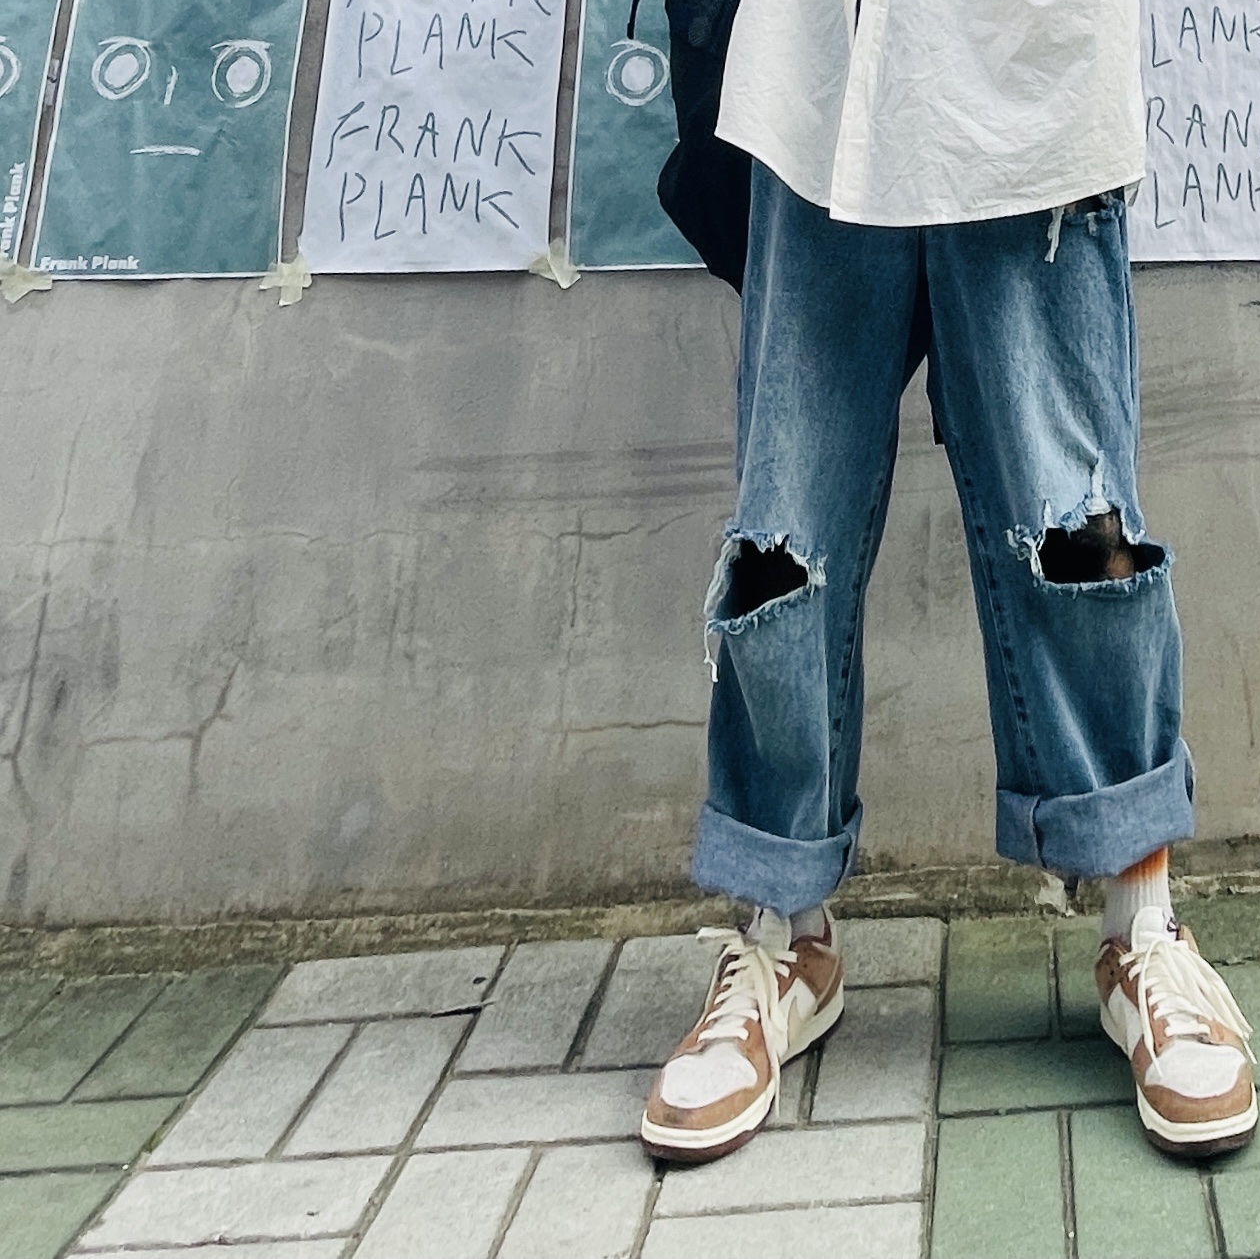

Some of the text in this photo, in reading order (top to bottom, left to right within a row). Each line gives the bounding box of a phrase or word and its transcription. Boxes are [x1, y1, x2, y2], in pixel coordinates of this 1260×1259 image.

[358, 11, 535, 79] PLANK
[325, 101, 543, 176] FRANK
[0, 161, 26, 259] rank Plank
[340, 172, 520, 243] PLANK
[40, 254, 140, 271] Frank Plank
